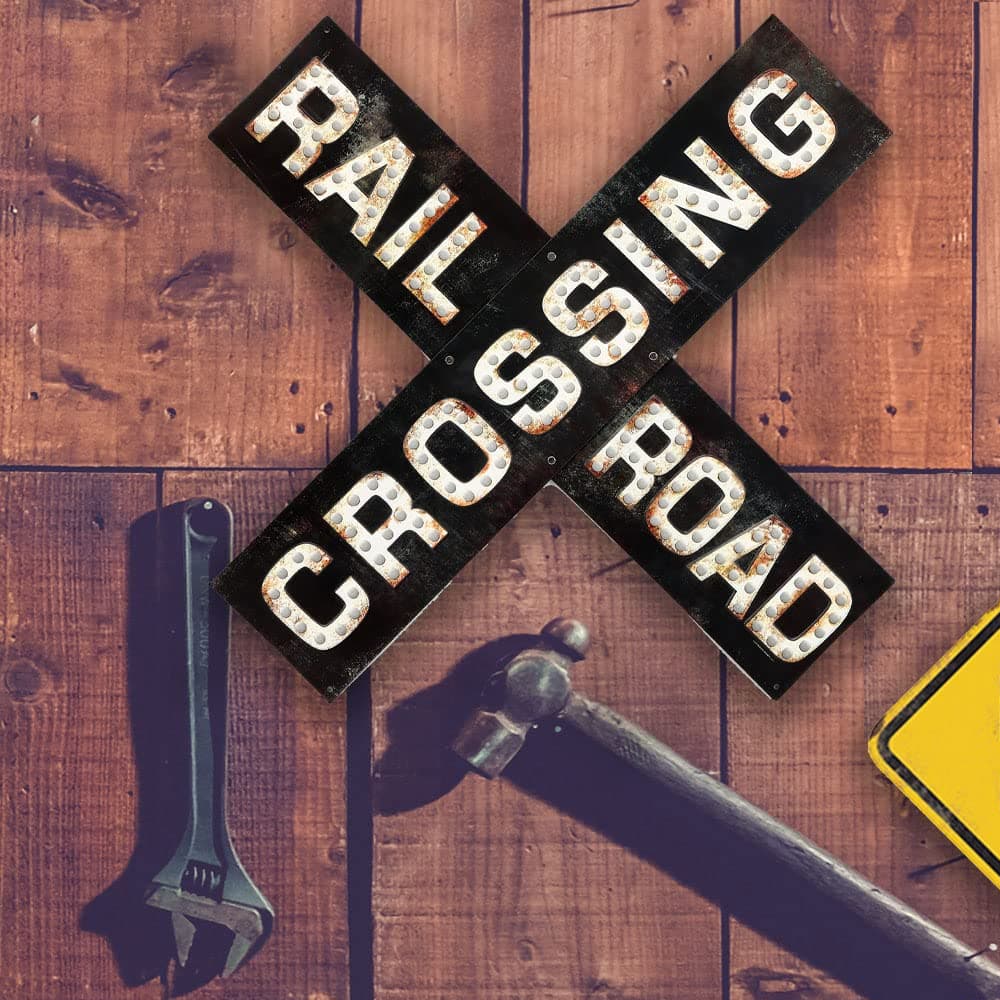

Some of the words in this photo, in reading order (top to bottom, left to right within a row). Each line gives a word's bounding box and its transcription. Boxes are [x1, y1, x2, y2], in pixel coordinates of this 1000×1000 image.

[245, 56, 487, 326] RAIL
[585, 396, 853, 663] ROAD
[261, 69, 836, 651] CROSSING
